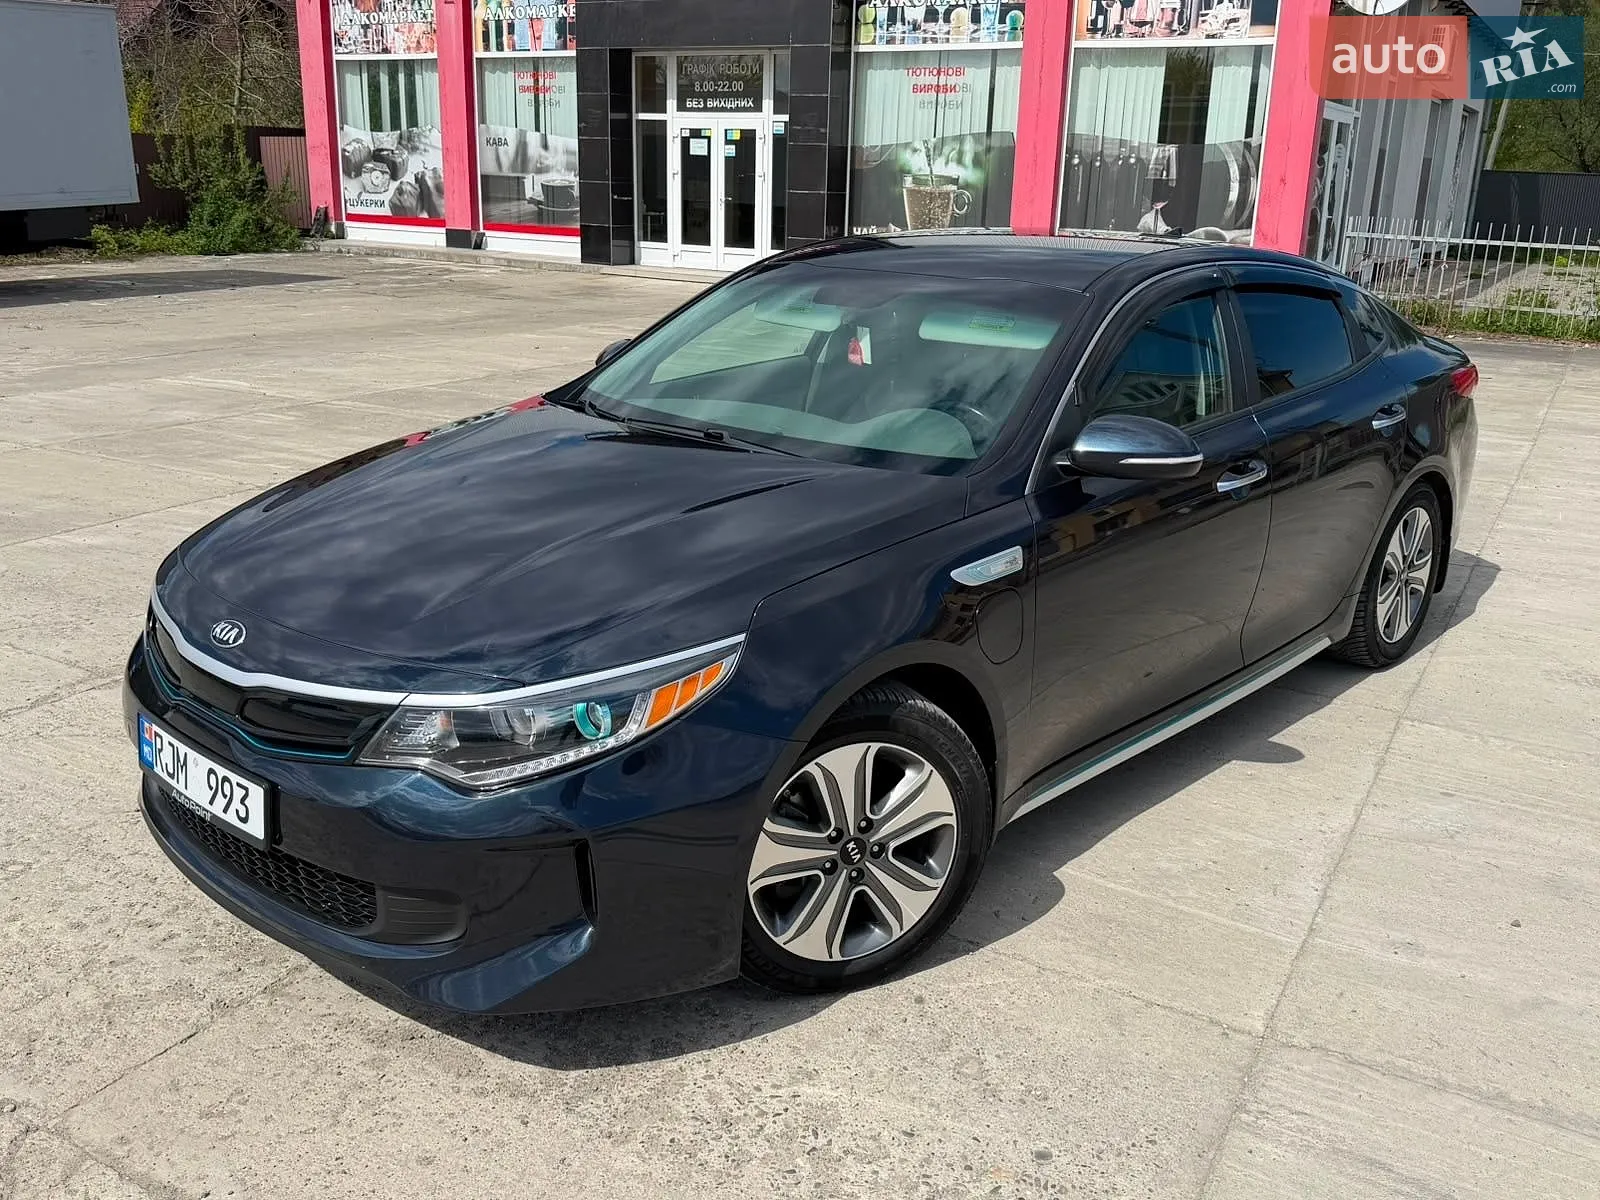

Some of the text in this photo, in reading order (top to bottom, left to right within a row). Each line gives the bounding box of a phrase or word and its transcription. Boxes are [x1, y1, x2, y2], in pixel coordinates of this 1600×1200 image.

[342, 9, 434, 26] АЛКОМАРКЕТ
[682, 63, 760, 76] ГРАФІК РОБОТИ
[906, 66, 966, 77] ТЮТЮНОВІ
[694, 81, 744, 92] 8.00-22.00
[912, 83, 957, 94] ВИРОБИ
[686, 97, 754, 110] БЕЗ ВИХІДНИХ
[486, 136, 509, 147] КАВА
[349, 198, 386, 209] ЦУКЕРКИ
[853, 225, 877, 235] ЧАЙ
[212, 622, 241, 645] KIA
[154, 730, 249, 824] RJM 993
[846, 841, 861, 863] KIA
